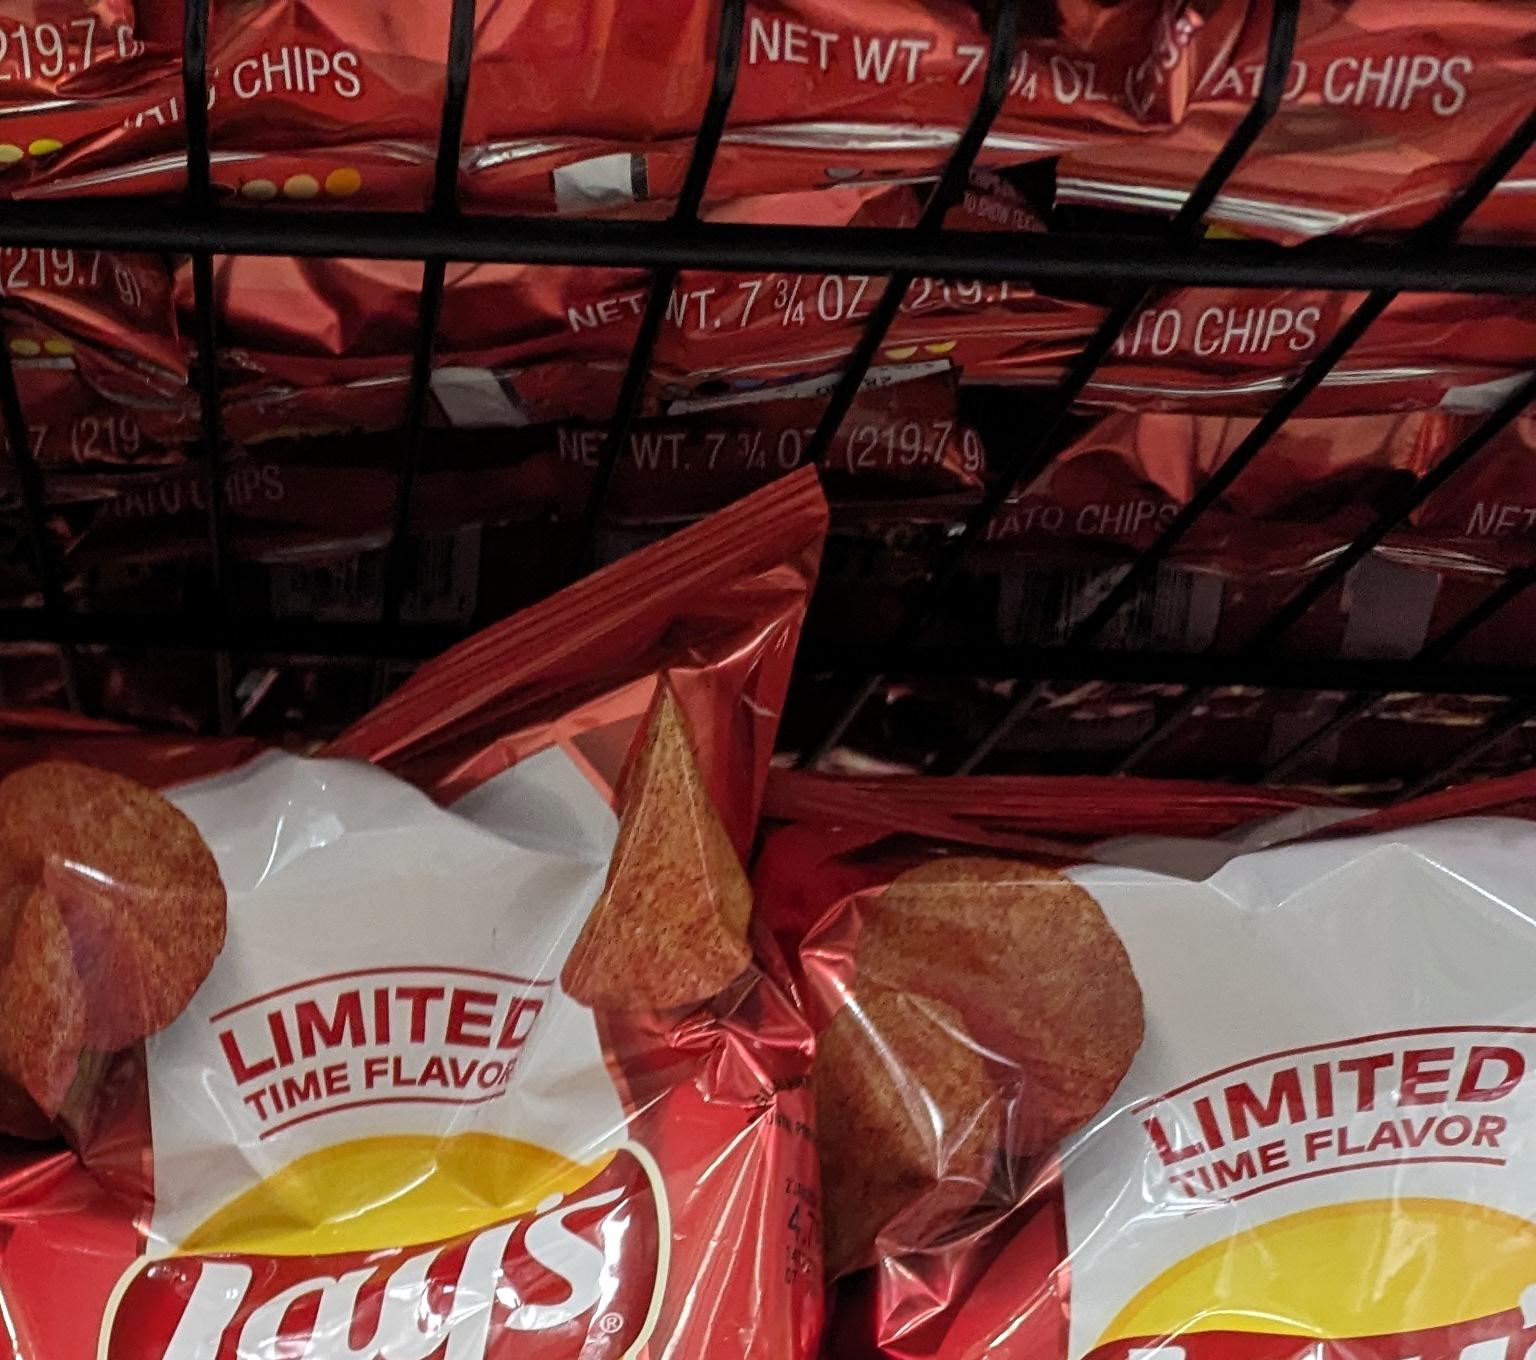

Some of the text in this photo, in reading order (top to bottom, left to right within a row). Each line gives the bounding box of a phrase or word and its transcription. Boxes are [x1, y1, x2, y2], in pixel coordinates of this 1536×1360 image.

[232, 45, 362, 99] CHIPS
[748, 17, 839, 71] NET
[956, 45, 986, 86] 7
[1322, 55, 1474, 117] CHIPS
[738, 280, 762, 328] 7
[1193, 307, 1322, 356] CHIPS
[218, 985, 545, 1086] LIMITED
[243, 1056, 521, 1123] TIME FLAVOR
[1143, 1044, 1526, 1168] LIMITED
[1169, 1114, 1508, 1199] TIME FLAVOR
